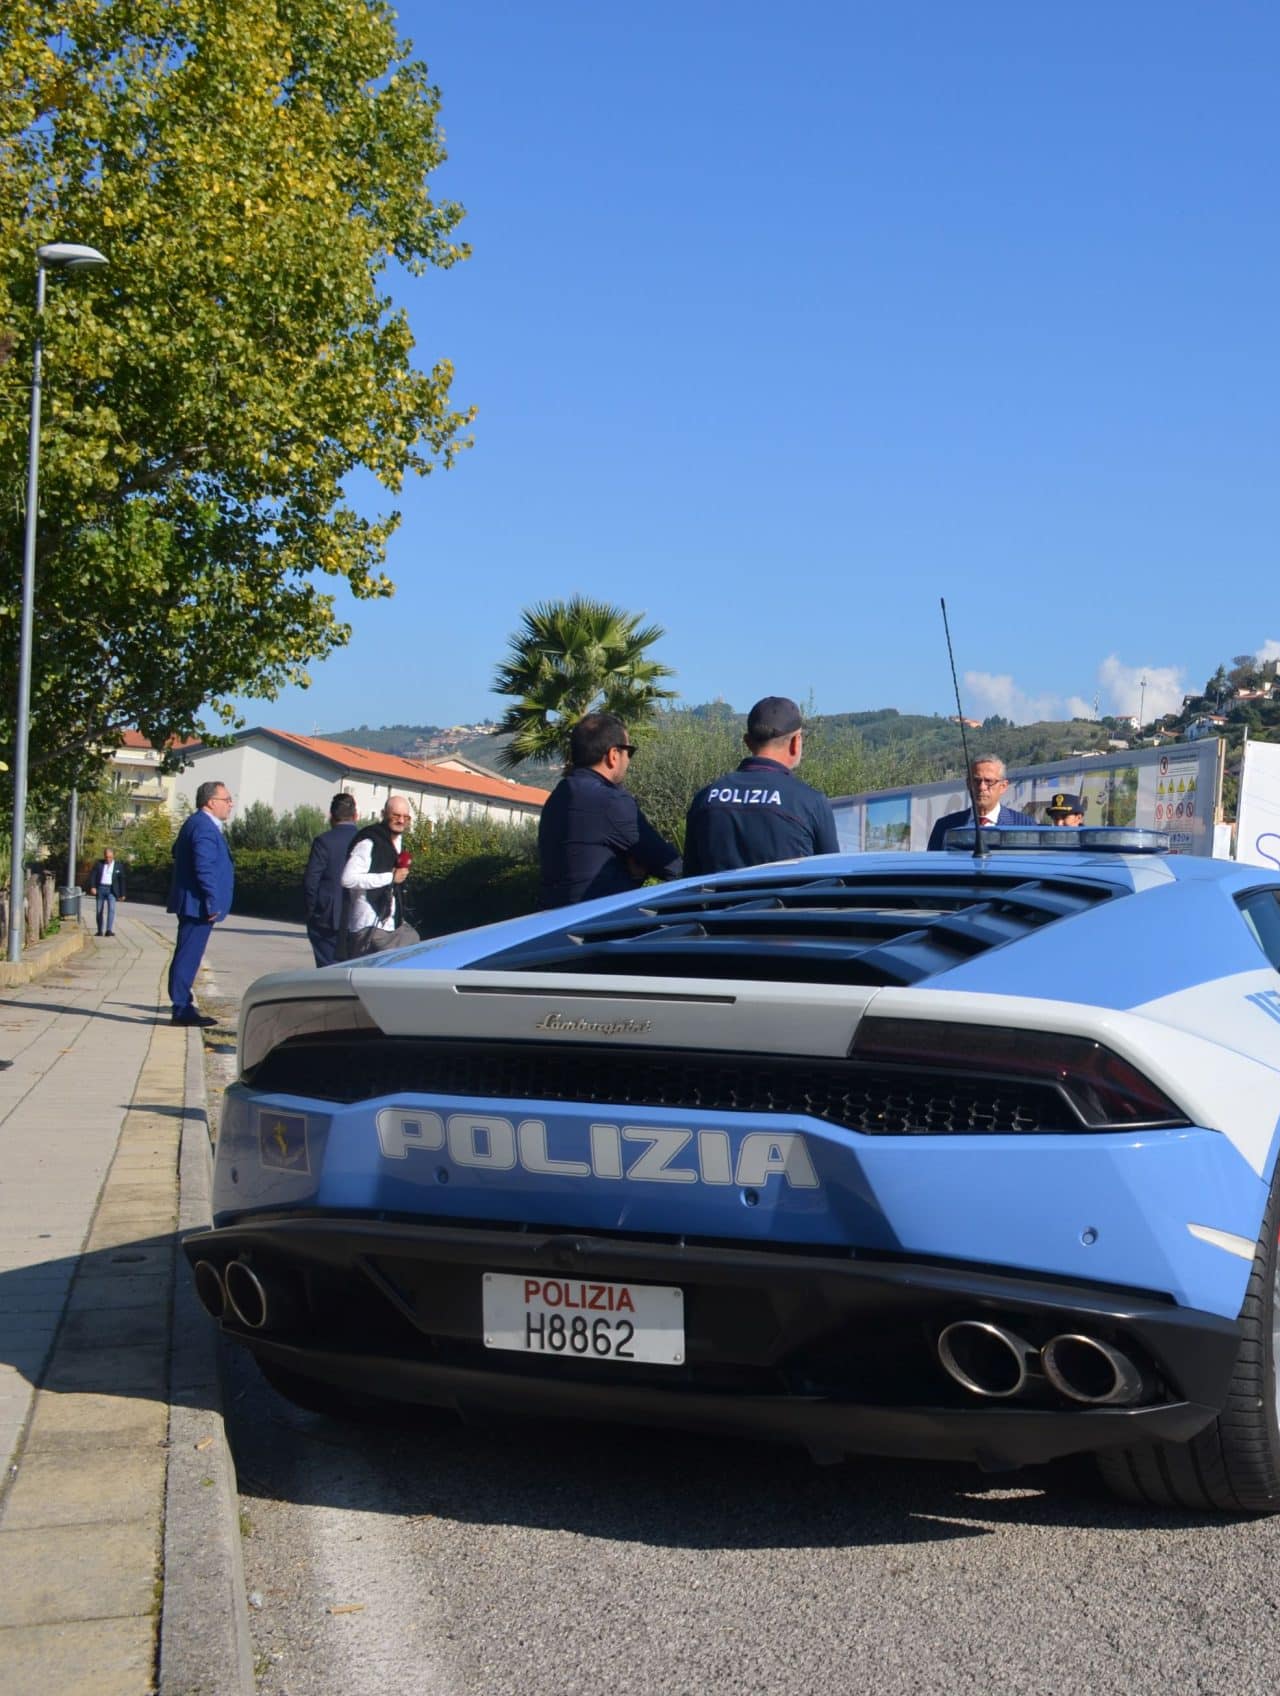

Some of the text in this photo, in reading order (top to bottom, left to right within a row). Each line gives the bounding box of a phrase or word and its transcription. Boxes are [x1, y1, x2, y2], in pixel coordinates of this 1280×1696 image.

[708, 788, 782, 805] POLIZIA
[535, 1013, 654, 1036] Lamborghini
[374, 1106, 820, 1190] POLIZIA
[523, 1279, 637, 1314] POLIZIA
[525, 1312, 636, 1360] H8862
